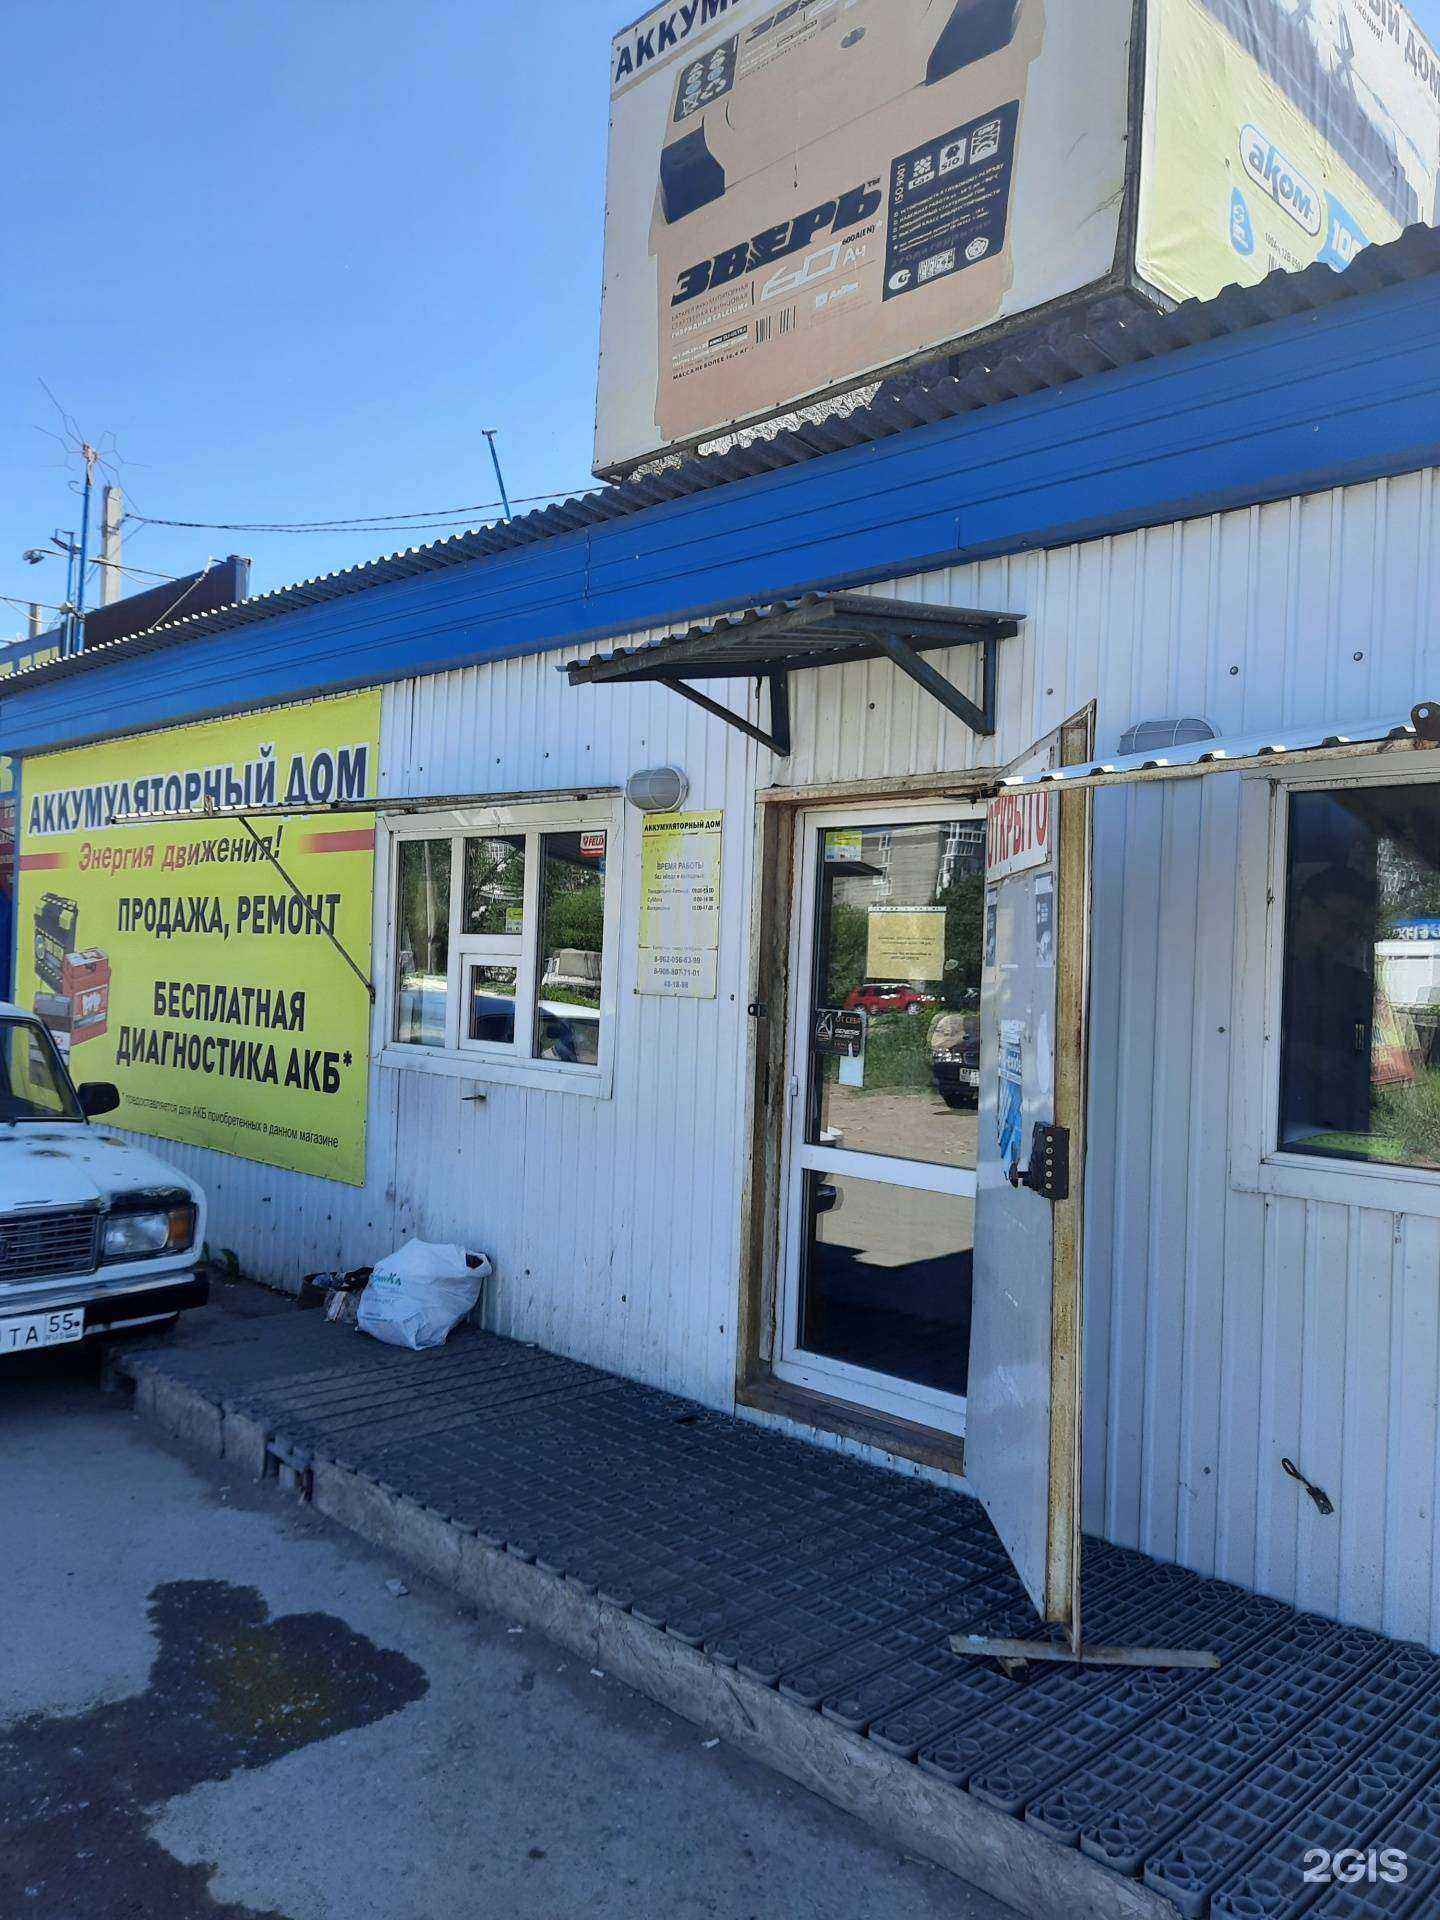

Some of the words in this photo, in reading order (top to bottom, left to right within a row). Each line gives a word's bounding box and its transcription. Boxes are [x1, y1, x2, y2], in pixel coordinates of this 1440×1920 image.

[615, 0, 740, 83] АККУМ
[671, 183, 882, 307] ЗВЕРЬ
[761, 242, 842, 301] 60
[29, 746, 275, 834] АККУМУЛЯТОРНЫЙ
[284, 747, 367, 805] ДОМ
[79, 842, 155, 876] Энергия
[161, 826, 283, 872] движения!
[644, 820, 704, 832] АККУМУЛЯТОРНЫЙ
[705, 821, 721, 829] ДОМ
[678, 861, 704, 870] РАБОТЫ
[117, 897, 230, 941] ПРОДАЖА,
[237, 893, 341, 935] РЕМОНТ
[154, 981, 305, 1032] БЕСПЛАТНАЯ
[116, 1027, 280, 1086] ДИАГНОСТИКА
[192, 1105, 207, 1119] АКБ
[269, 1123, 298, 1140] данном
[300, 1129, 339, 1148] магазине
[9, 1326, 38, 1346] ТА
[49, 1312, 74, 1333] 55
